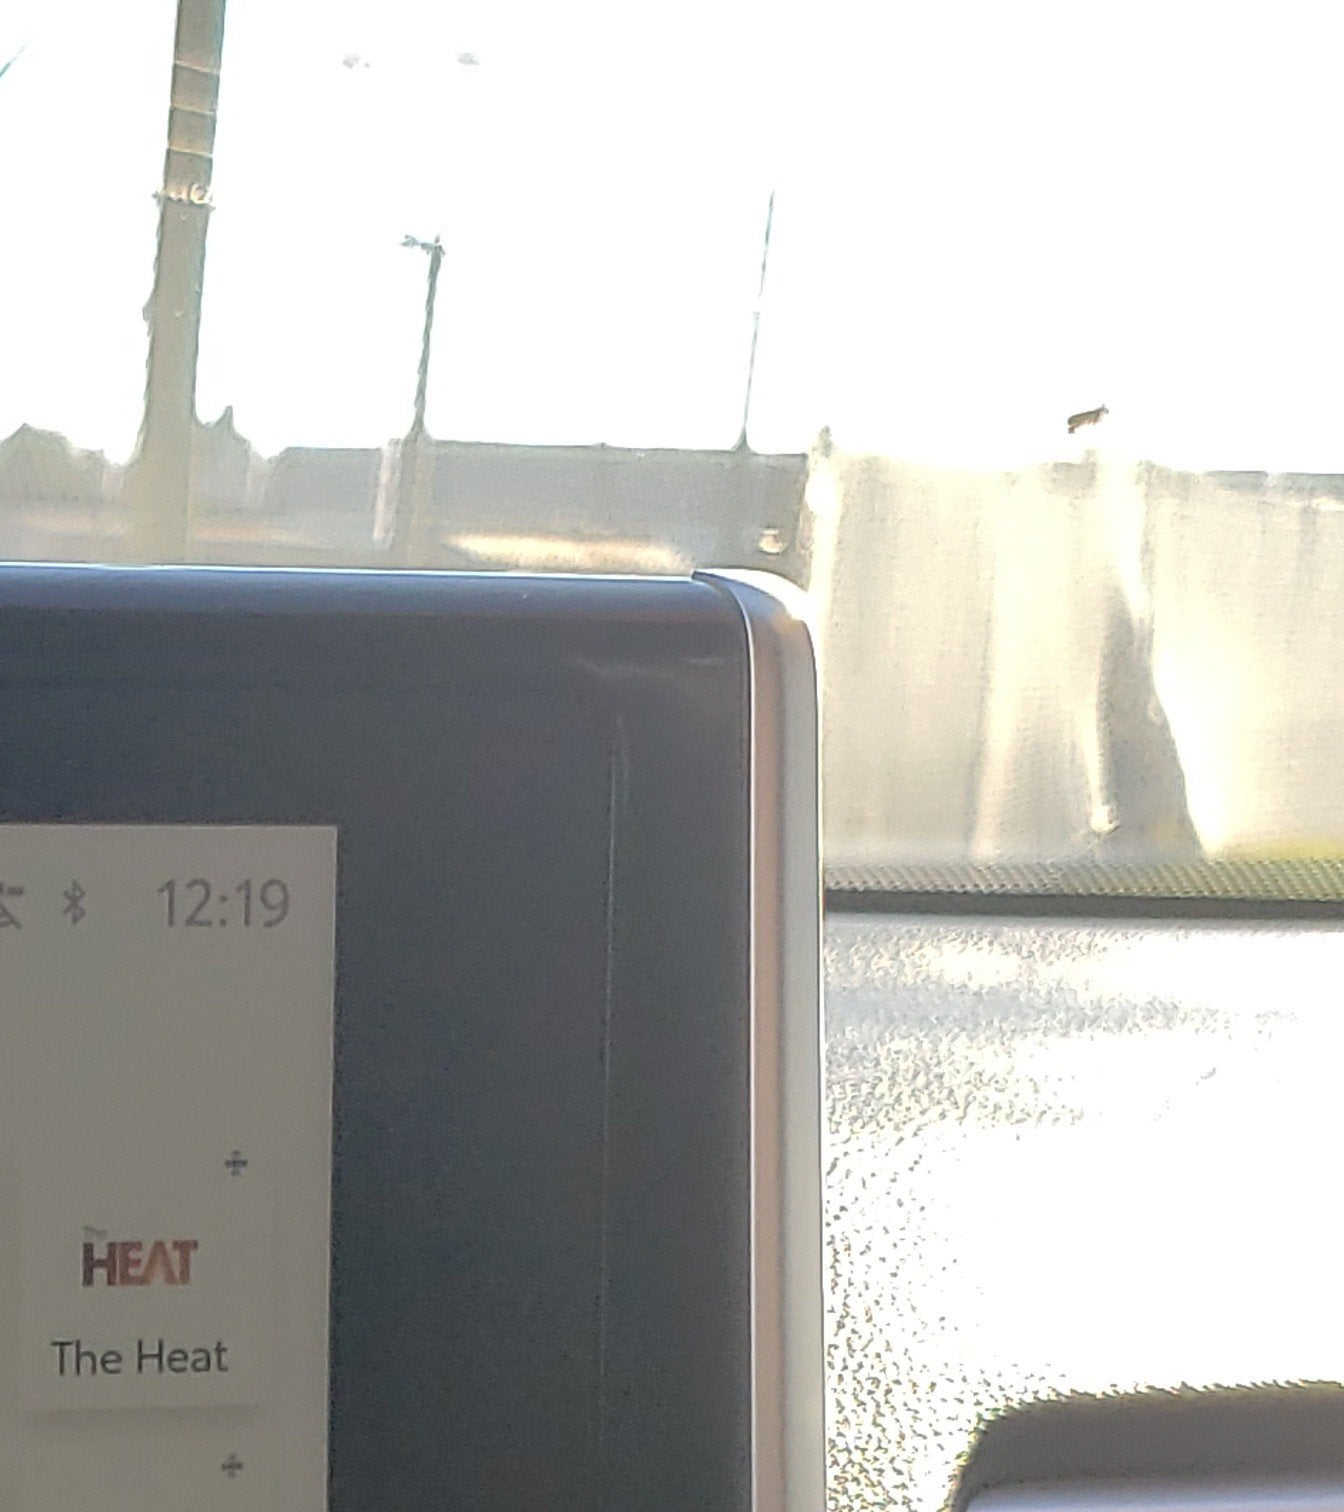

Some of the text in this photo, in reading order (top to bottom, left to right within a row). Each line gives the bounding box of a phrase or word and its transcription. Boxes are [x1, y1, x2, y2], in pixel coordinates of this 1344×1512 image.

[158, 877, 290, 929] 12:19
[82, 1239, 199, 1287] HEAT
[50, 1338, 229, 1377] The Heat
